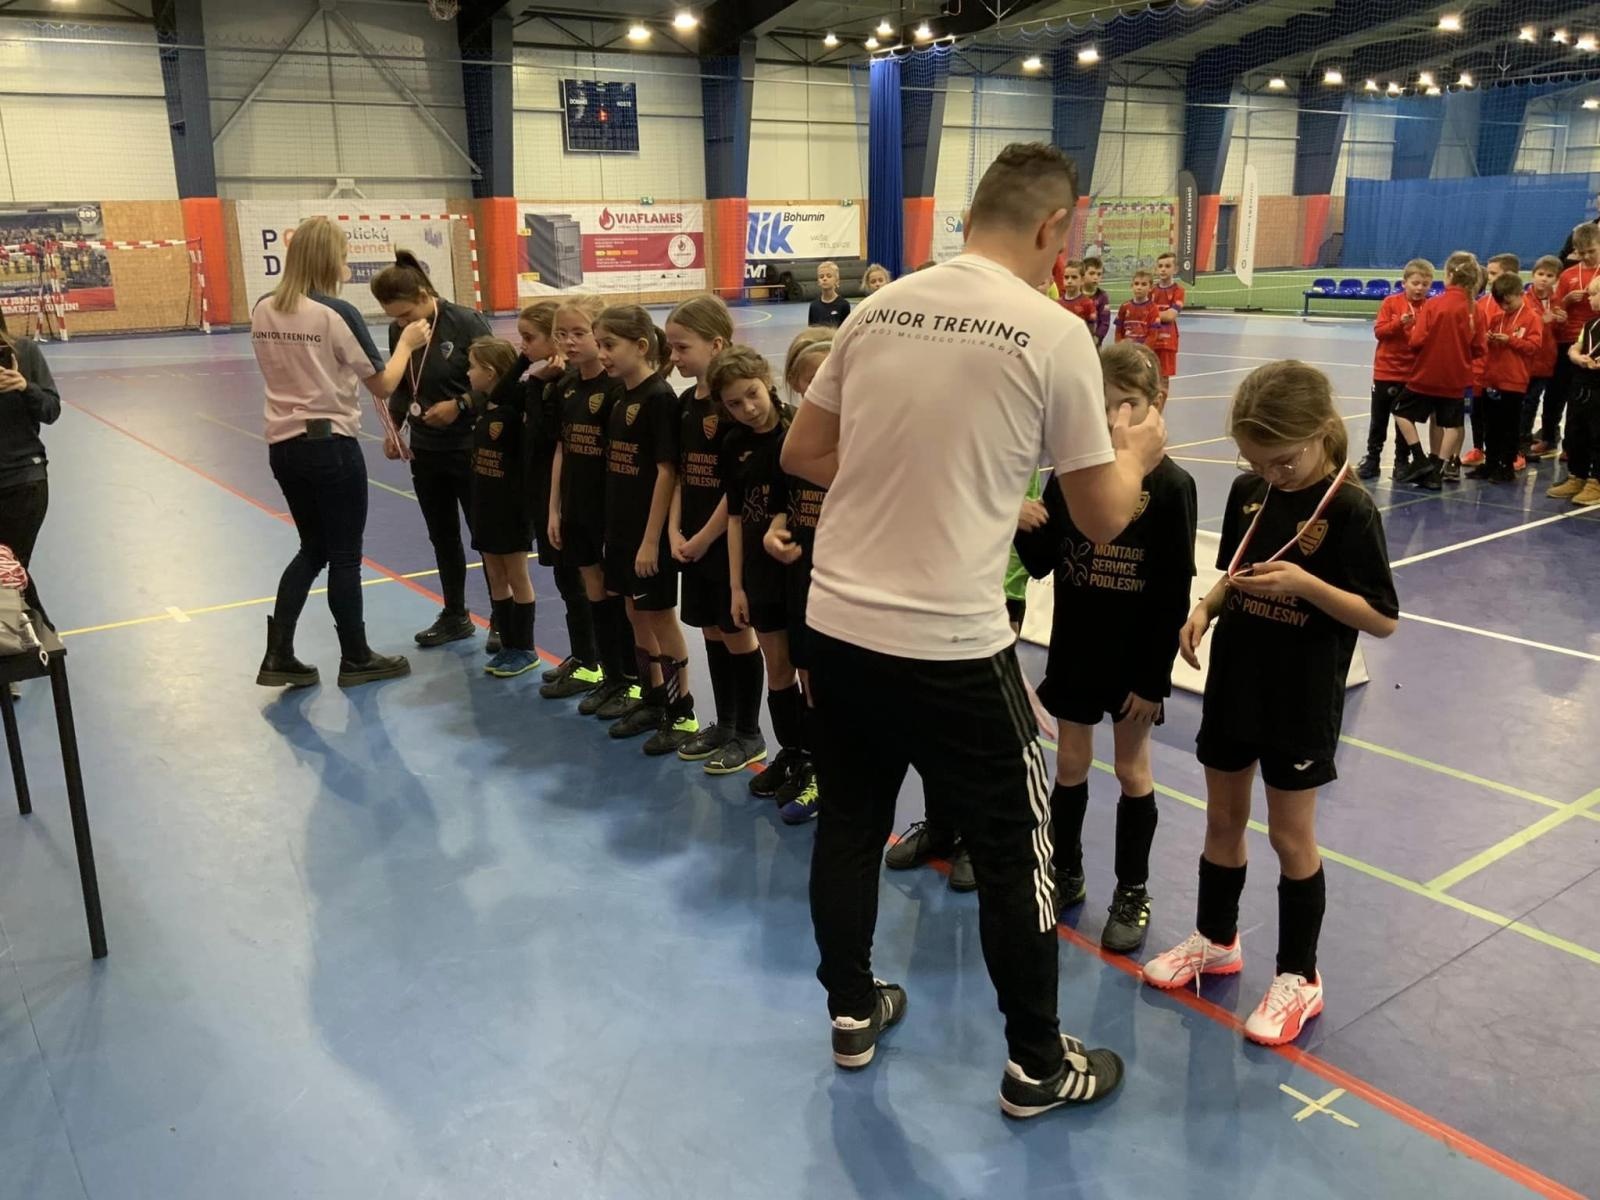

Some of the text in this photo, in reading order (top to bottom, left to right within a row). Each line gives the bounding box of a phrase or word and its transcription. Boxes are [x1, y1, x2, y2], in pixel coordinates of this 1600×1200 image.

[616, 213, 683, 224] VIAFLAMES
[348, 243, 393, 253] ternet
[253, 331, 321, 343] JUNIOR TRENING
[858, 309, 1031, 349] JUNIOR TRENING
[801, 489, 826, 502] MONT
[1094, 543, 1145, 561] MONTAGE
[1092, 558, 1137, 576] SERVICE
[1089, 573, 1146, 592] PODLESNY
[1243, 597, 1309, 627] PODLESNY
